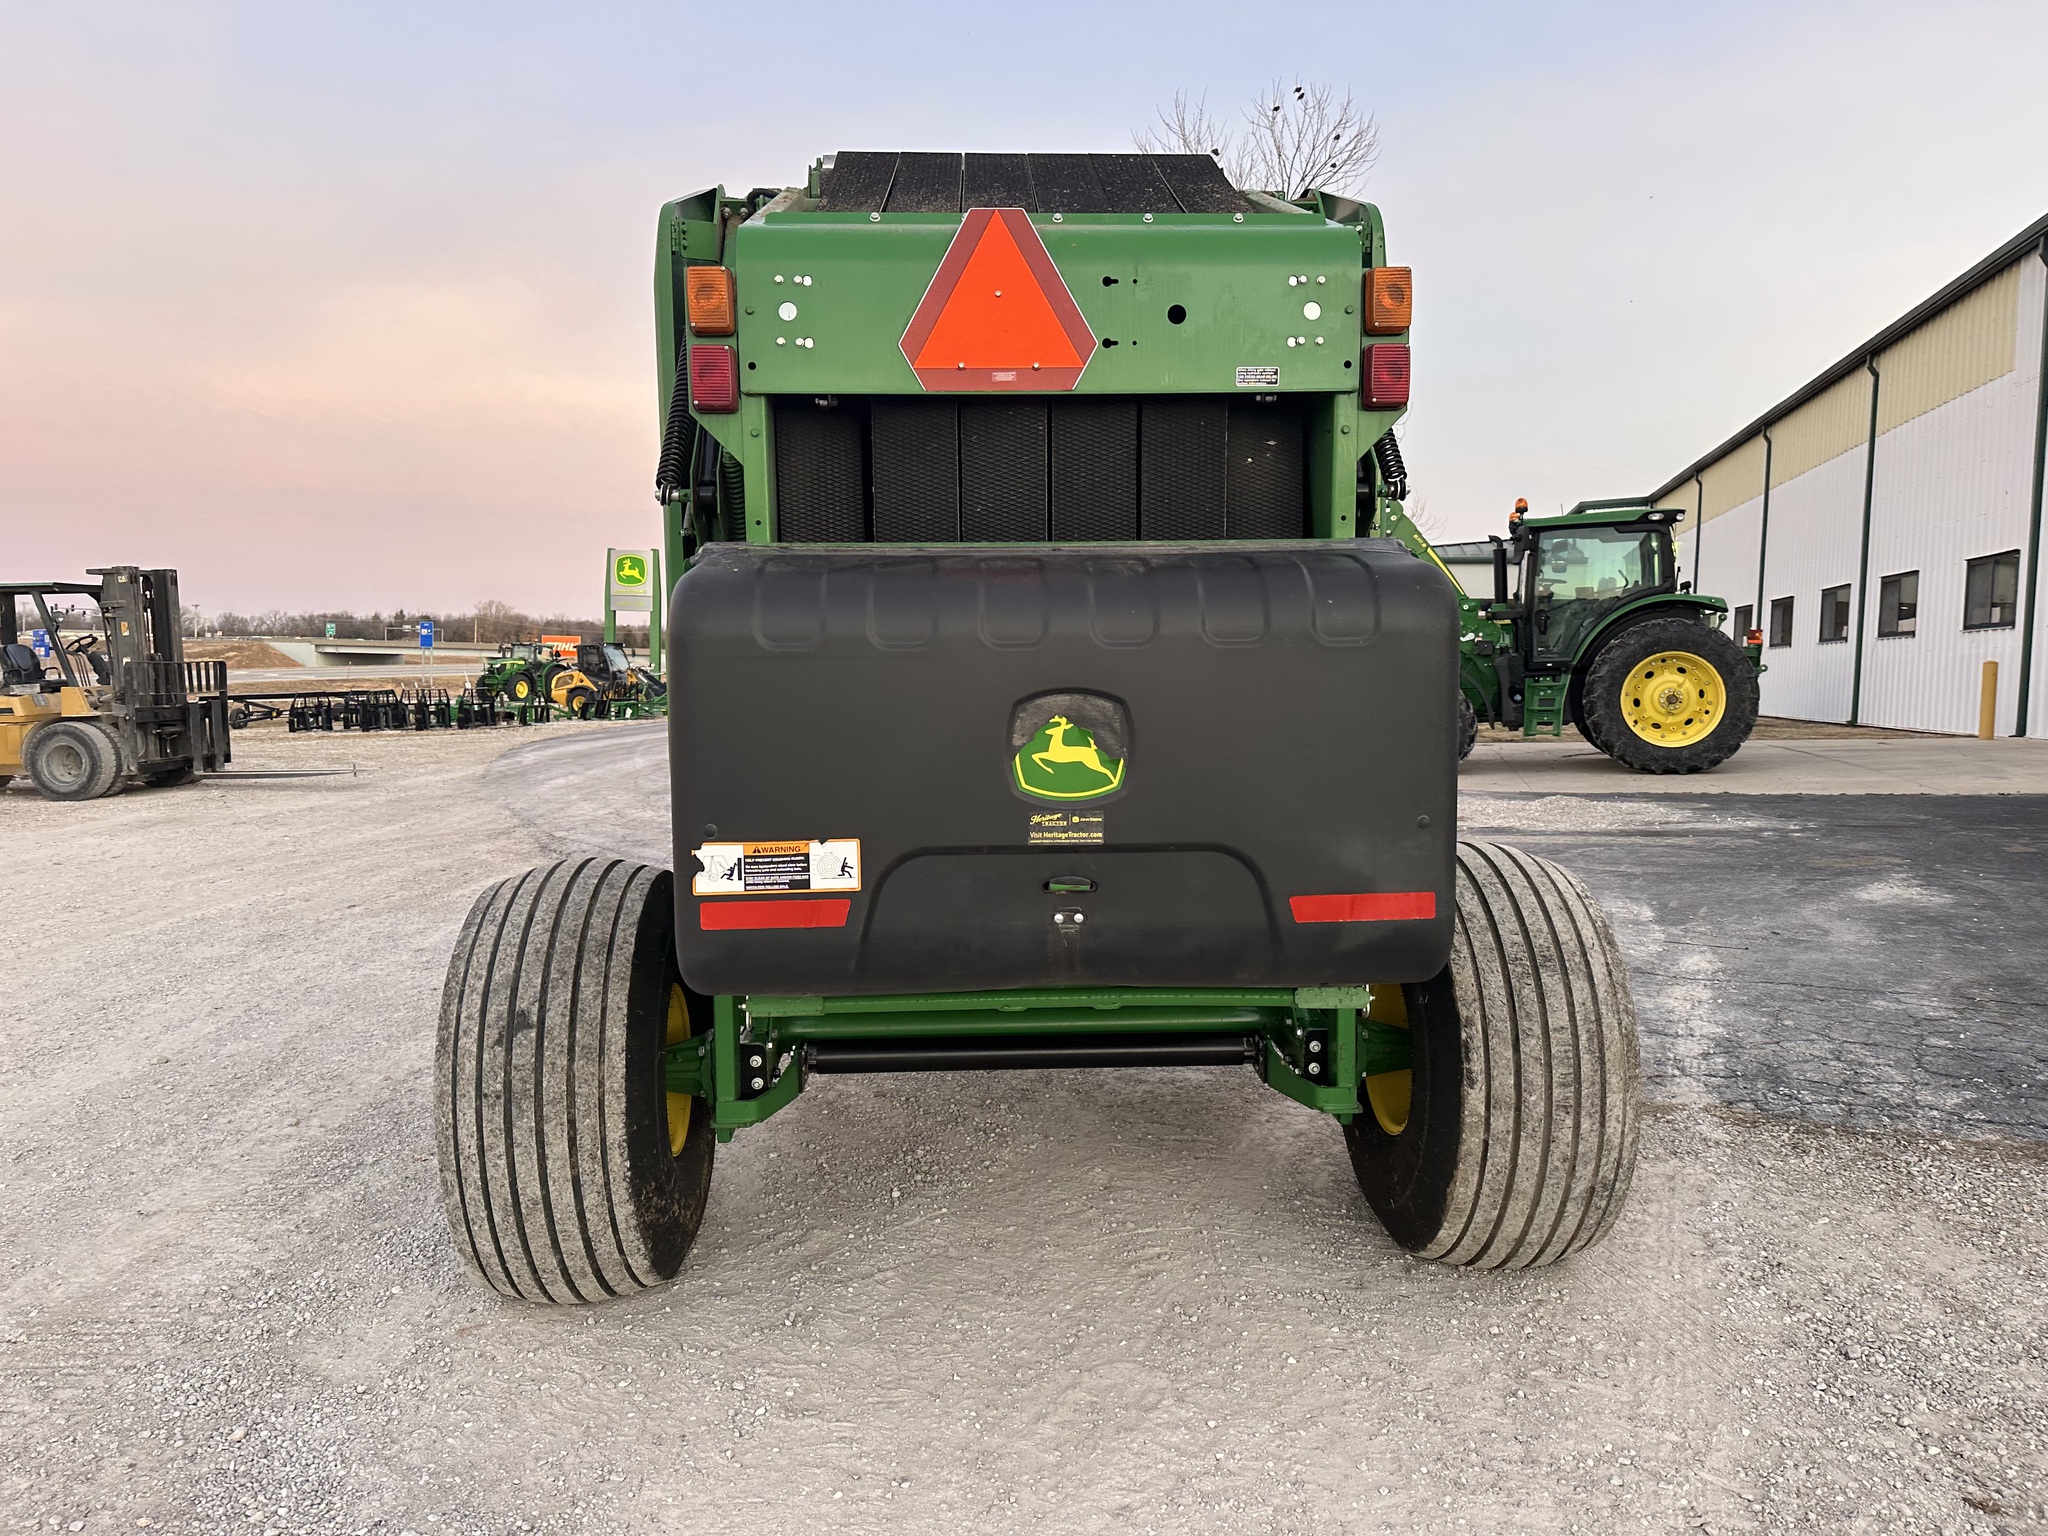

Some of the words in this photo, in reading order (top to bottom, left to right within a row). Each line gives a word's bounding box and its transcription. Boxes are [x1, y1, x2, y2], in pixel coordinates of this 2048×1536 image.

[1030, 813, 1062, 825] Heritage
[1043, 831, 1103, 839] HeritageTractor.com
[761, 845, 801, 853] WARNING
